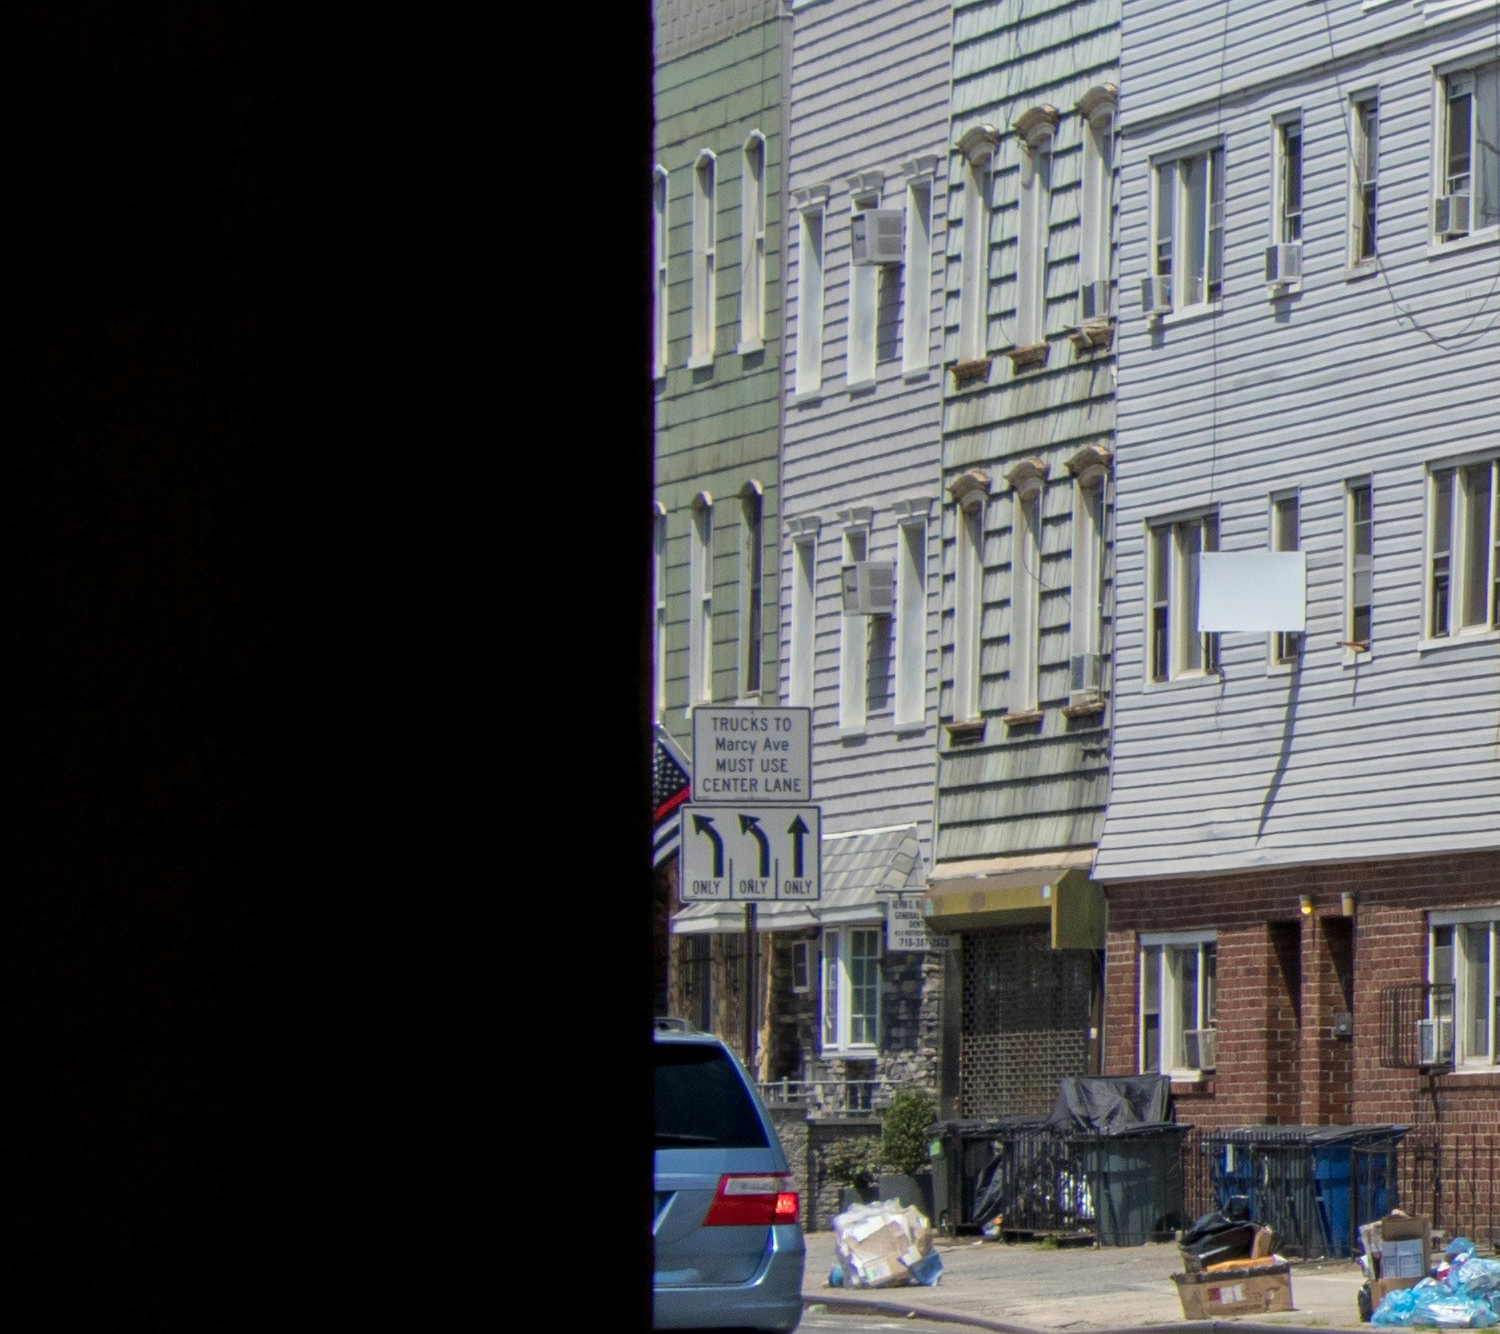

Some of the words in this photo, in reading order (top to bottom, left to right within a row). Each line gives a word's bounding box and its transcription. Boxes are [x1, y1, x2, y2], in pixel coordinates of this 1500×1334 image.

[712, 717, 769, 731] TRUCKS
[775, 717, 792, 731] TO
[715, 737, 757, 754] Marcy
[763, 737, 789, 752] Ave
[716, 758, 754, 773] MUST
[760, 758, 788, 773] USE
[703, 778, 758, 792] CENTER
[765, 778, 801, 792] LANE
[692, 880, 721, 895] ONLY
[739, 880, 768, 894] ONLY
[784, 880, 813, 894] ONLY
